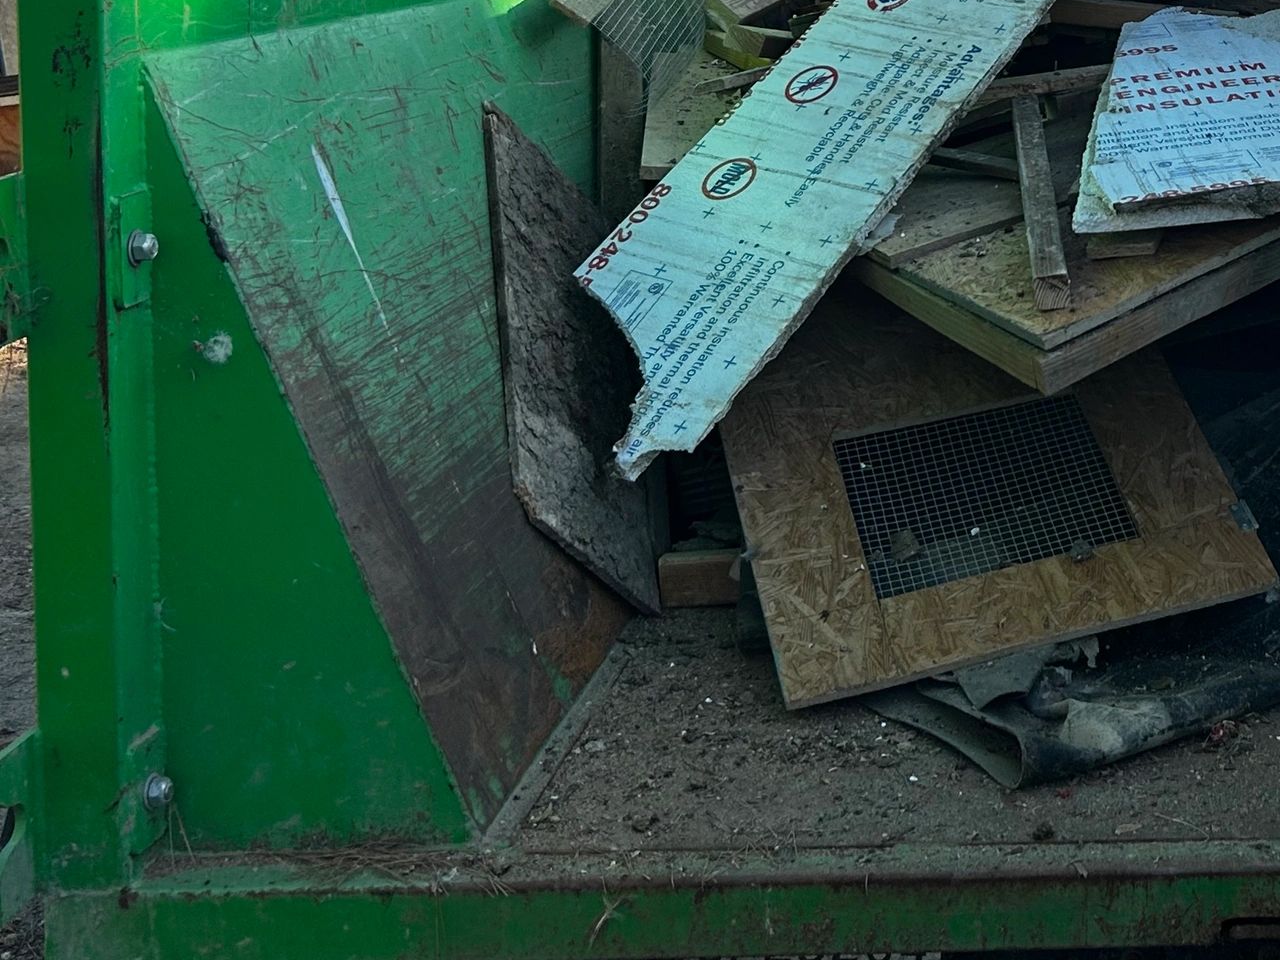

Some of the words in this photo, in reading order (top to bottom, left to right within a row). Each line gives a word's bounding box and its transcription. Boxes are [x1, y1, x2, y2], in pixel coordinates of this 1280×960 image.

[856, 42, 913, 97] Lightweight
[901, 79, 917, 88] &
[910, 49, 943, 77] Insect
[914, 52, 958, 93] Moisture
[1110, 62, 1266, 86] PREMIUM
[850, 98, 865, 106] &
[879, 90, 908, 114] Mold
[903, 44, 985, 125] Advantages:
[847, 122, 863, 131] &
[856, 98, 884, 120] Cuts
[873, 96, 921, 142] Resistant
[801, 109, 857, 161] Recyclable
[810, 133, 854, 174] Handles
[837, 116, 886, 163] Resistant
[1096, 127, 1162, 139] ntinuous
[1134, 140, 1212, 153] Warranted
[781, 177, 818, 207] Easily
[702, 249, 739, 280] 100%
[702, 253, 755, 303] Excellent
[713, 257, 770, 313] infiltration
[724, 260, 787, 323] Continuous
[653, 284, 711, 342] Warranted
[654, 305, 713, 360] Versatility
[693, 317, 722, 339] and
[654, 342, 701, 388] thermal
[676, 327, 734, 384] insulation
[637, 387, 687, 435] reduces
[621, 439, 645, 456] air
